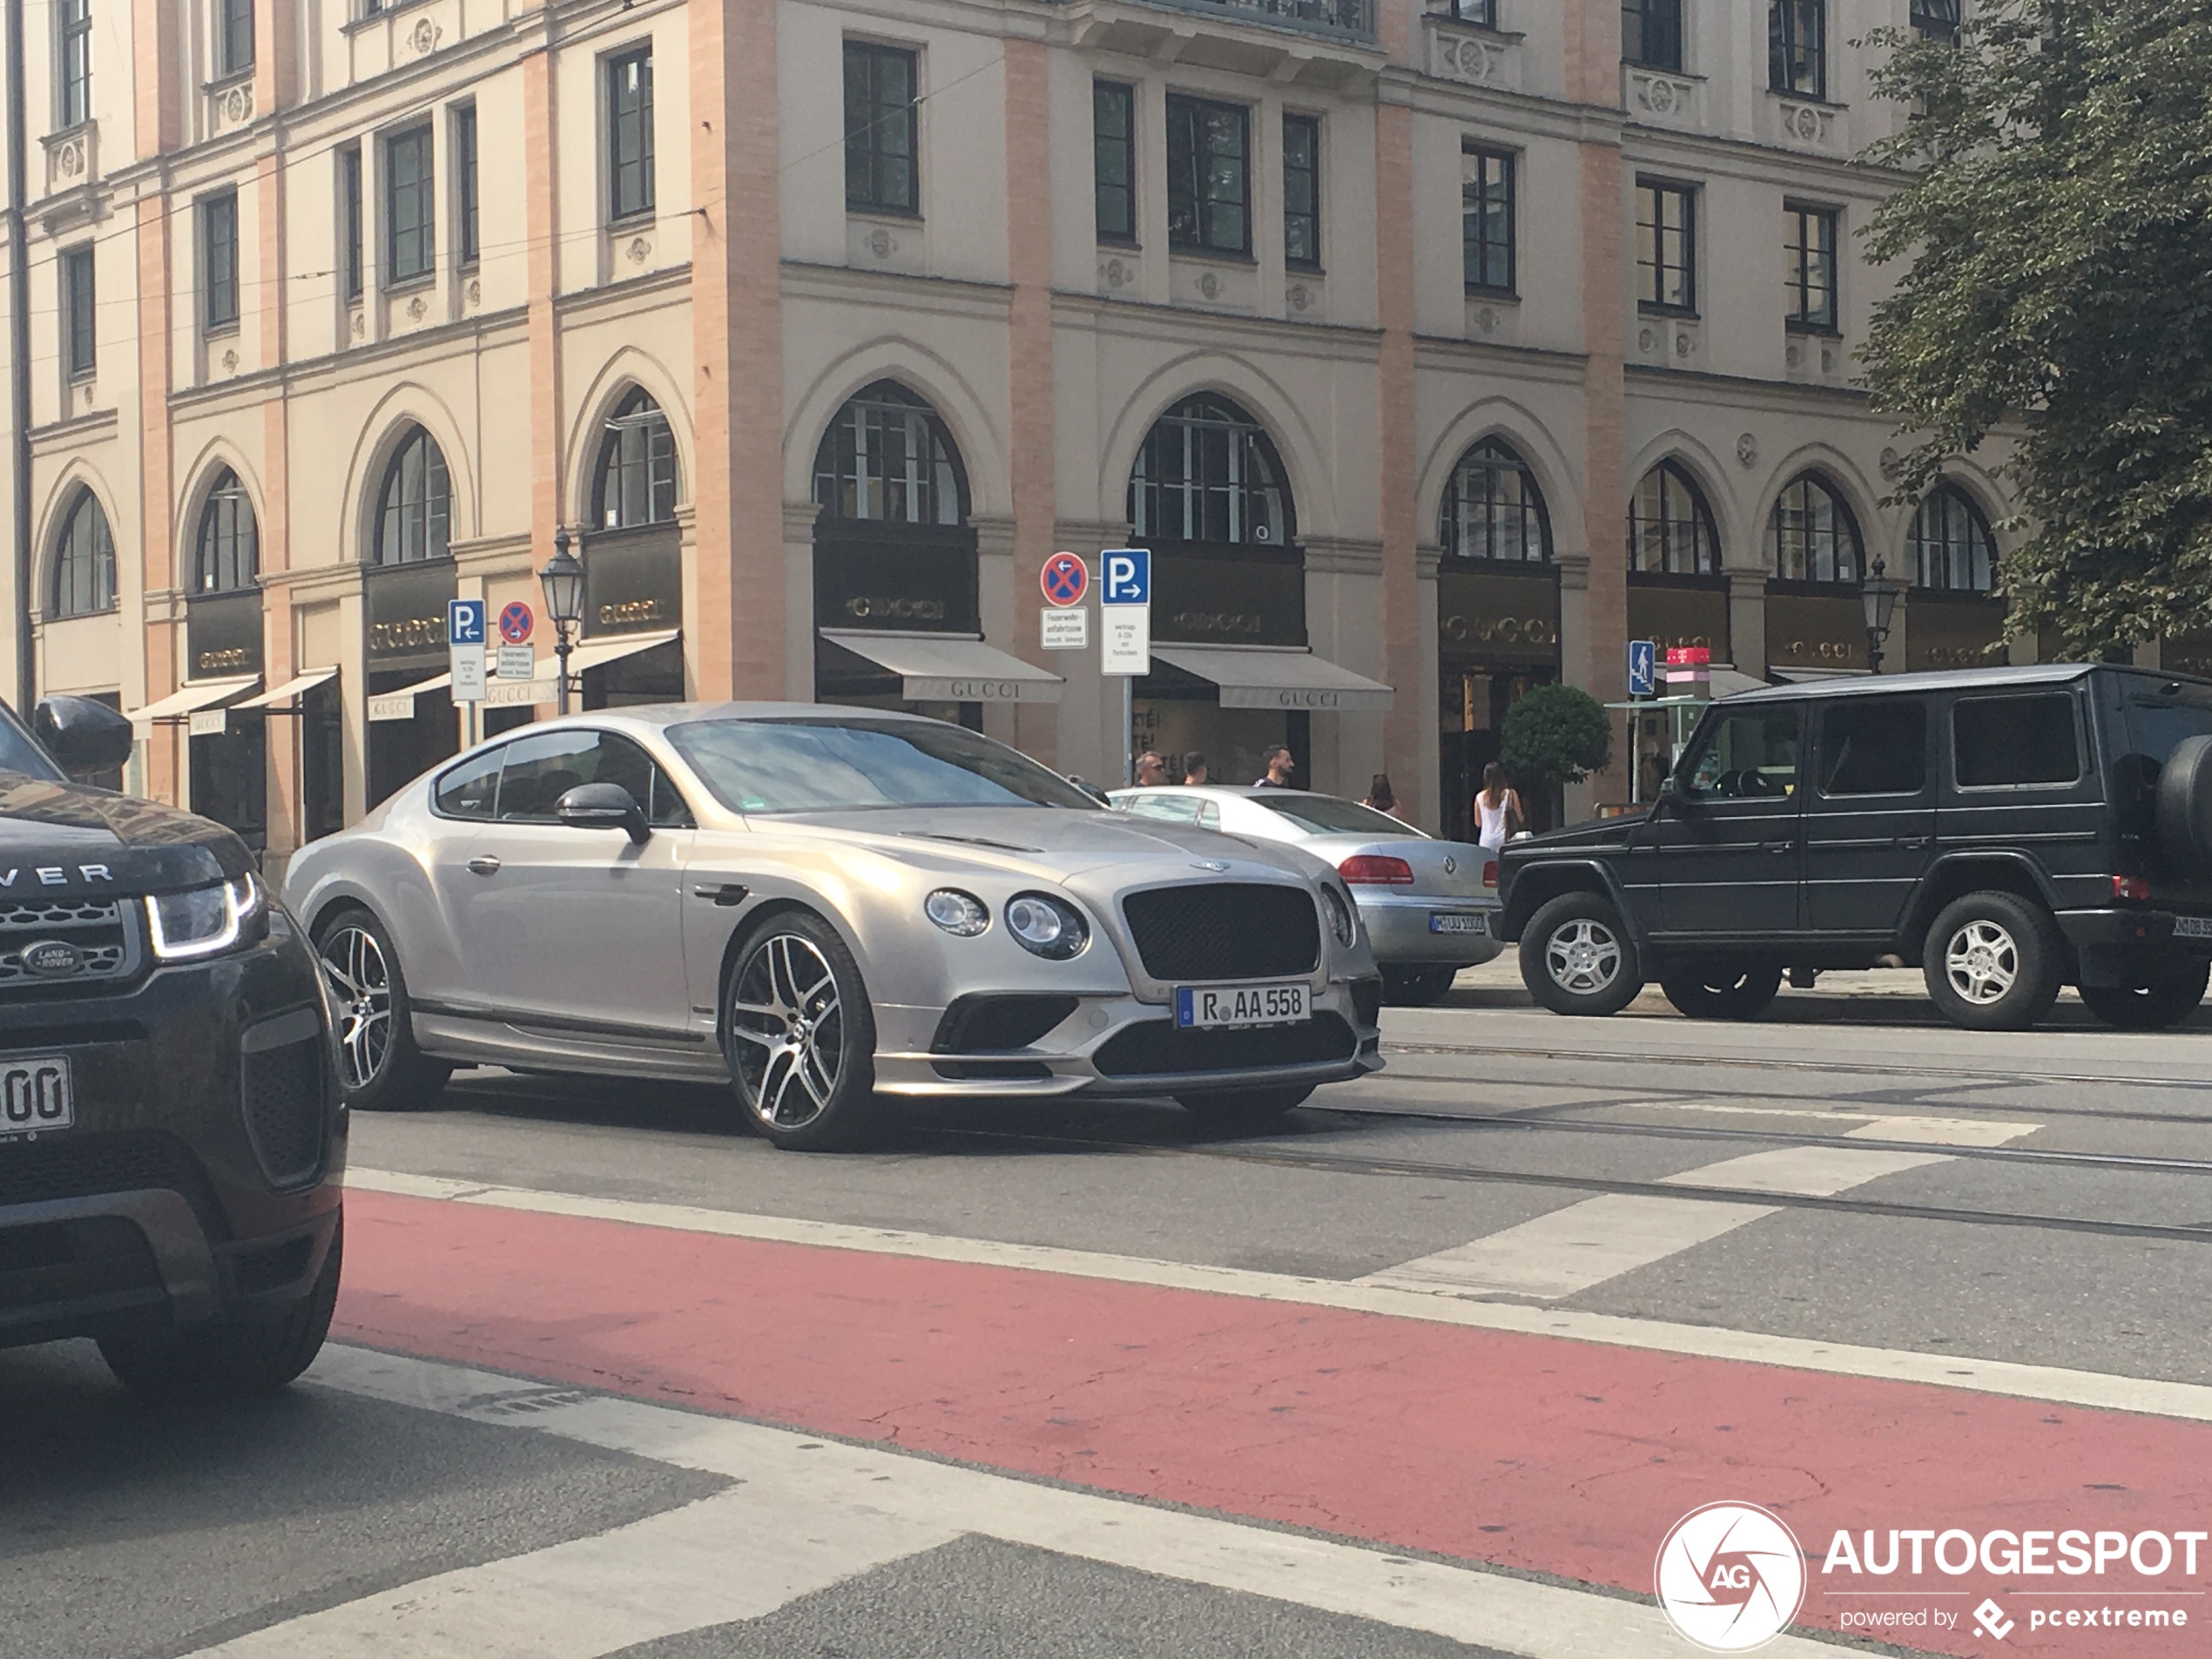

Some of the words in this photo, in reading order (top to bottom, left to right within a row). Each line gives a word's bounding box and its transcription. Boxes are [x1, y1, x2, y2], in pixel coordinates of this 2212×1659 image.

[1109, 557, 1136, 598] P
[455, 605, 475, 639] P
[1790, 640, 1852, 658] GCCI
[488, 686, 531, 705] GUCCI
[951, 681, 1020, 698] GUCCI
[1279, 691, 1339, 707] GUCCI
[1203, 993, 1217, 1020] R
[1234, 991, 1262, 1018] AA
[1266, 988, 1302, 1016] 558
